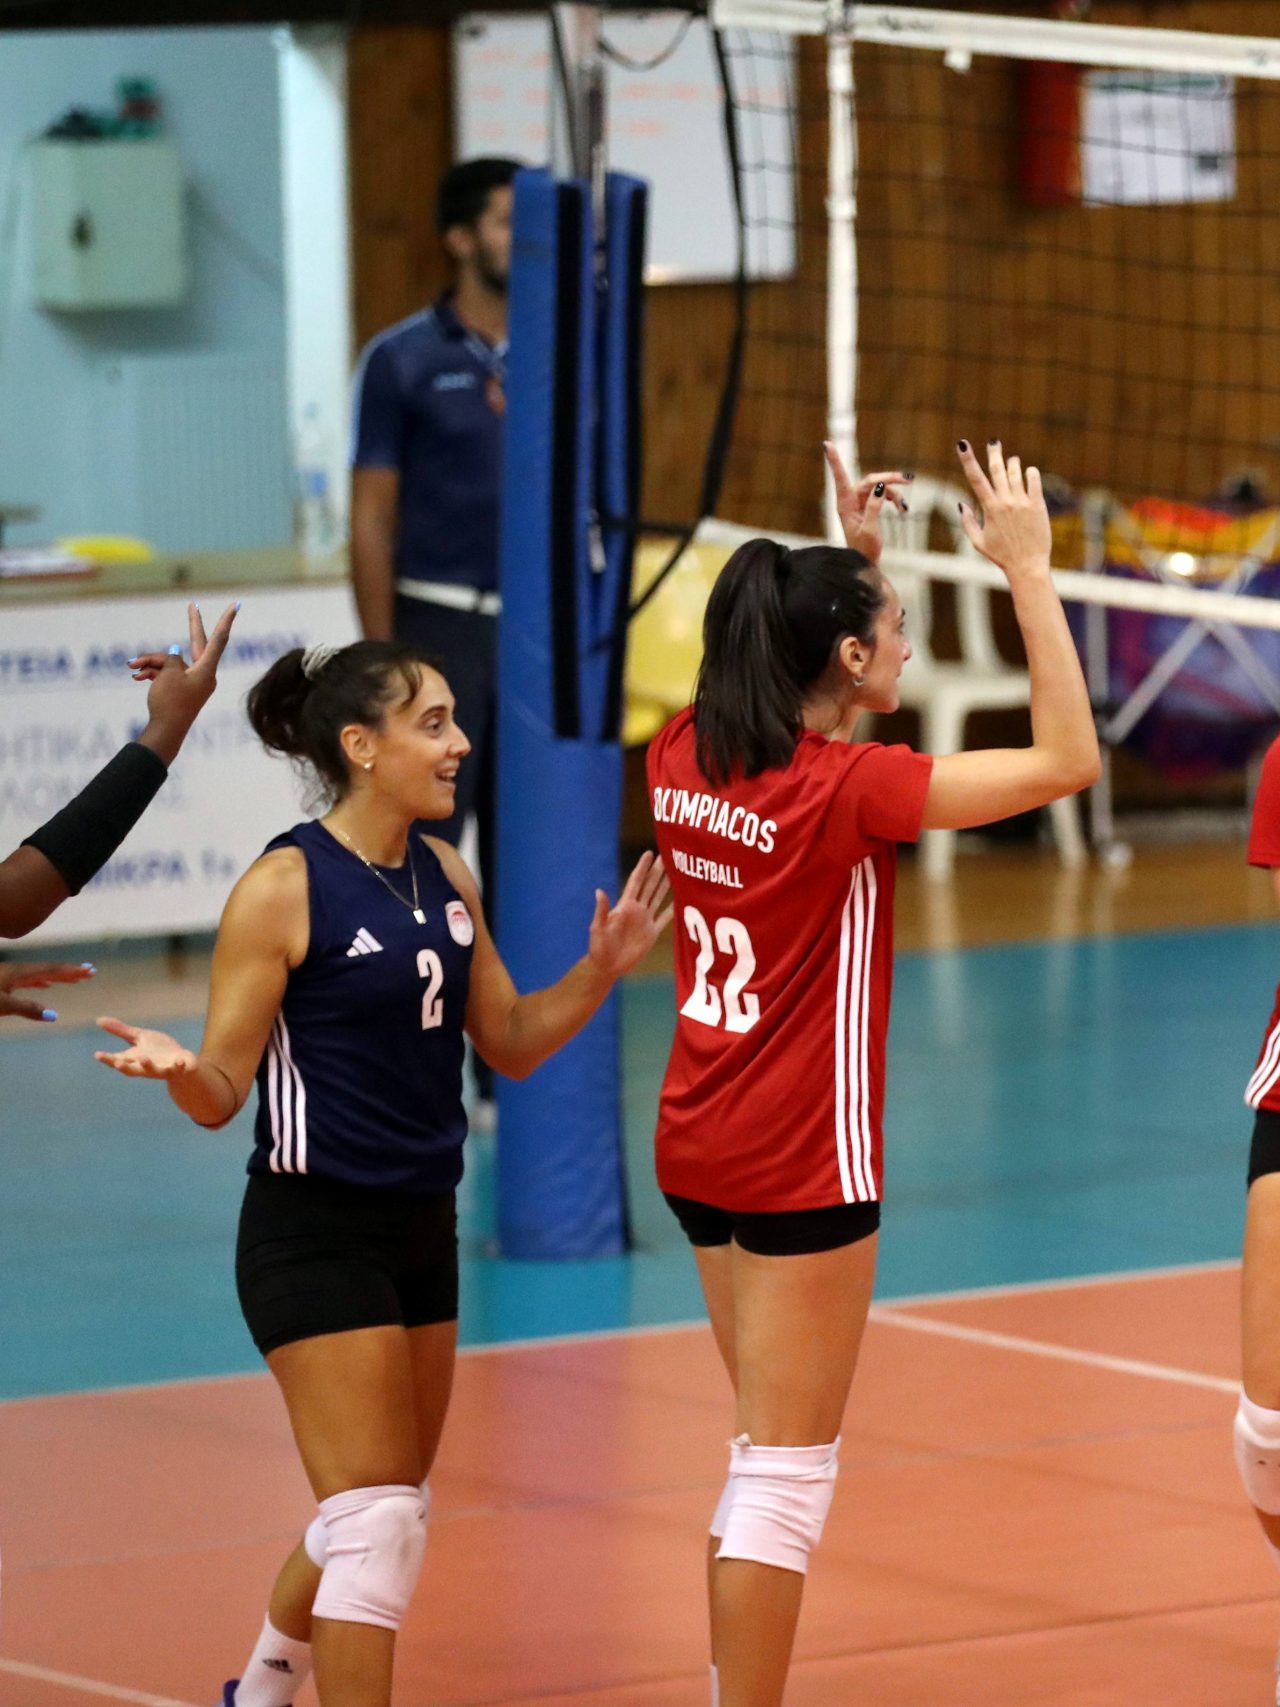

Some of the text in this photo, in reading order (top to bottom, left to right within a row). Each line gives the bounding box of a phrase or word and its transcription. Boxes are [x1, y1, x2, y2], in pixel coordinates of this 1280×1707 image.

[653, 787, 777, 853] OLYMPIACOS
[672, 848, 744, 889] VOLLEYBALL
[416, 949, 444, 1031] 2
[680, 905, 761, 1034] 22
